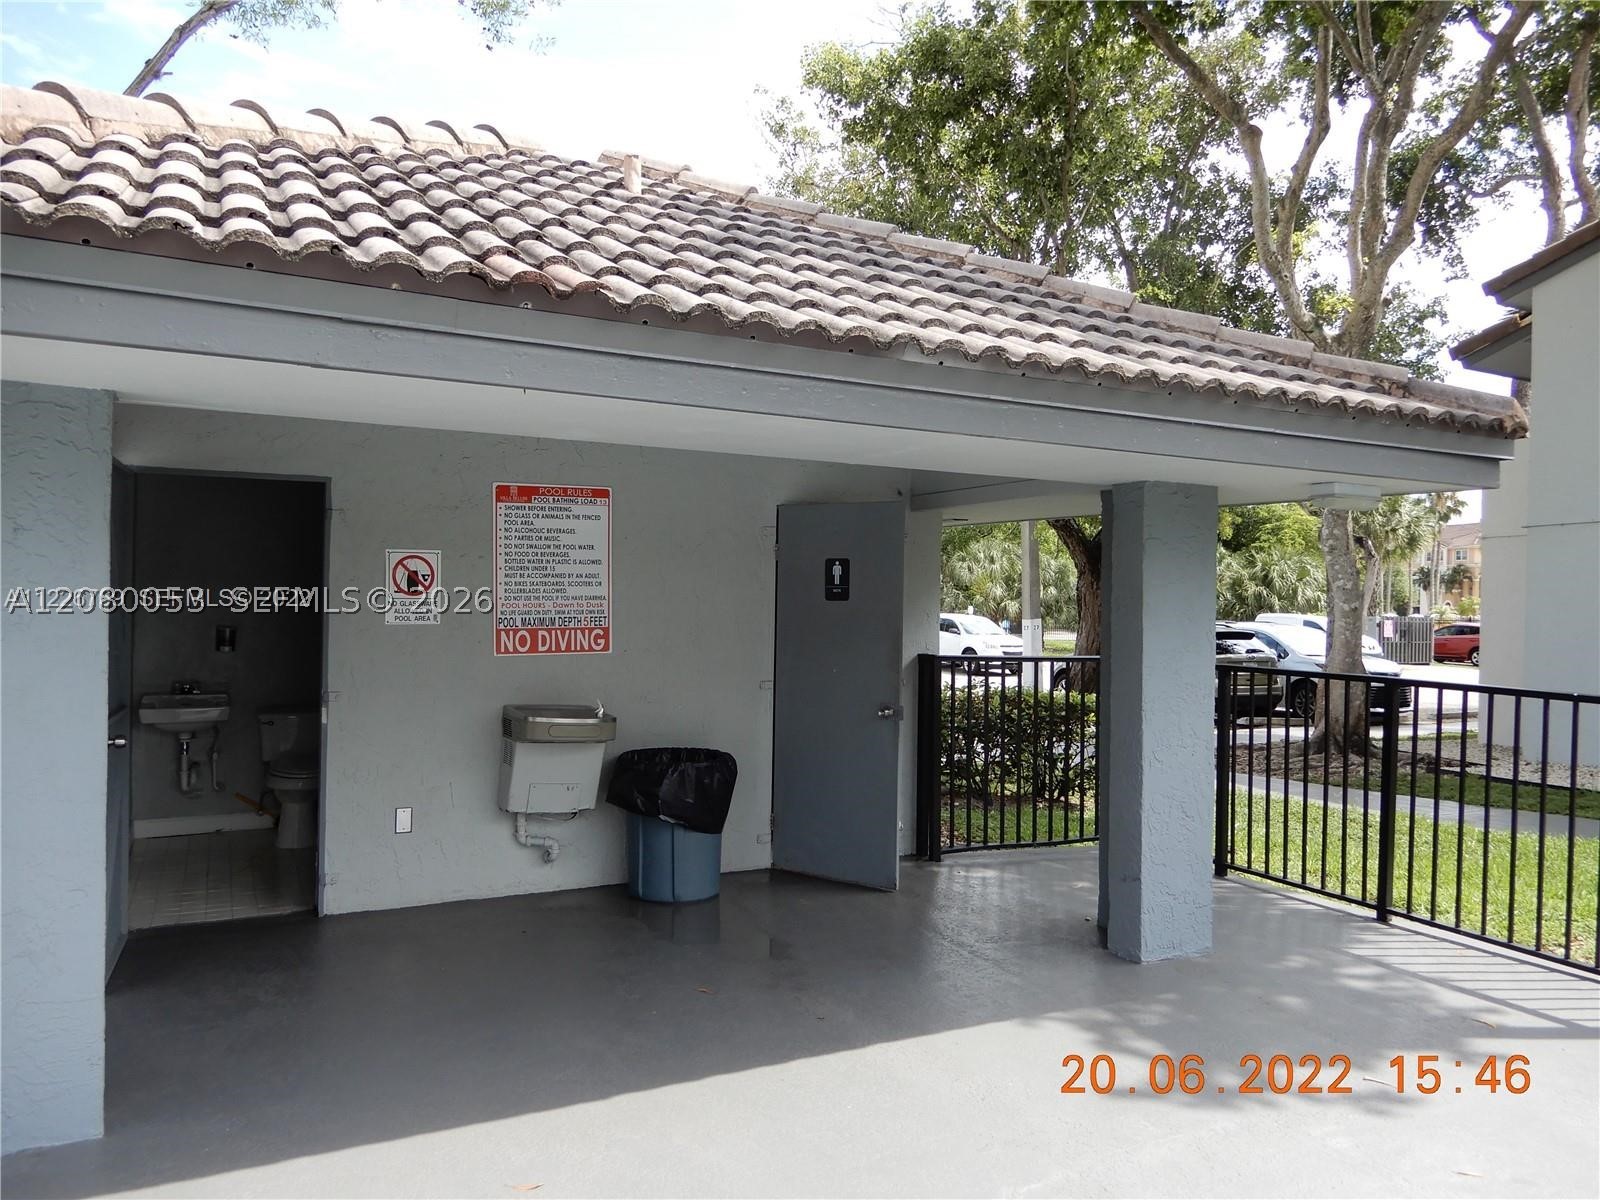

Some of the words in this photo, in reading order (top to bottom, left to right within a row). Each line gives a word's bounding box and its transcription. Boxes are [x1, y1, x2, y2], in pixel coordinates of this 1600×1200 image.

[539, 488, 565, 496] POOL
[498, 618, 519, 627] POOL
[521, 617, 556, 627] MAXIMUM
[558, 617, 581, 627] DEPTH
[500, 630, 531, 652] NO
[538, 629, 606, 652] DIVING
